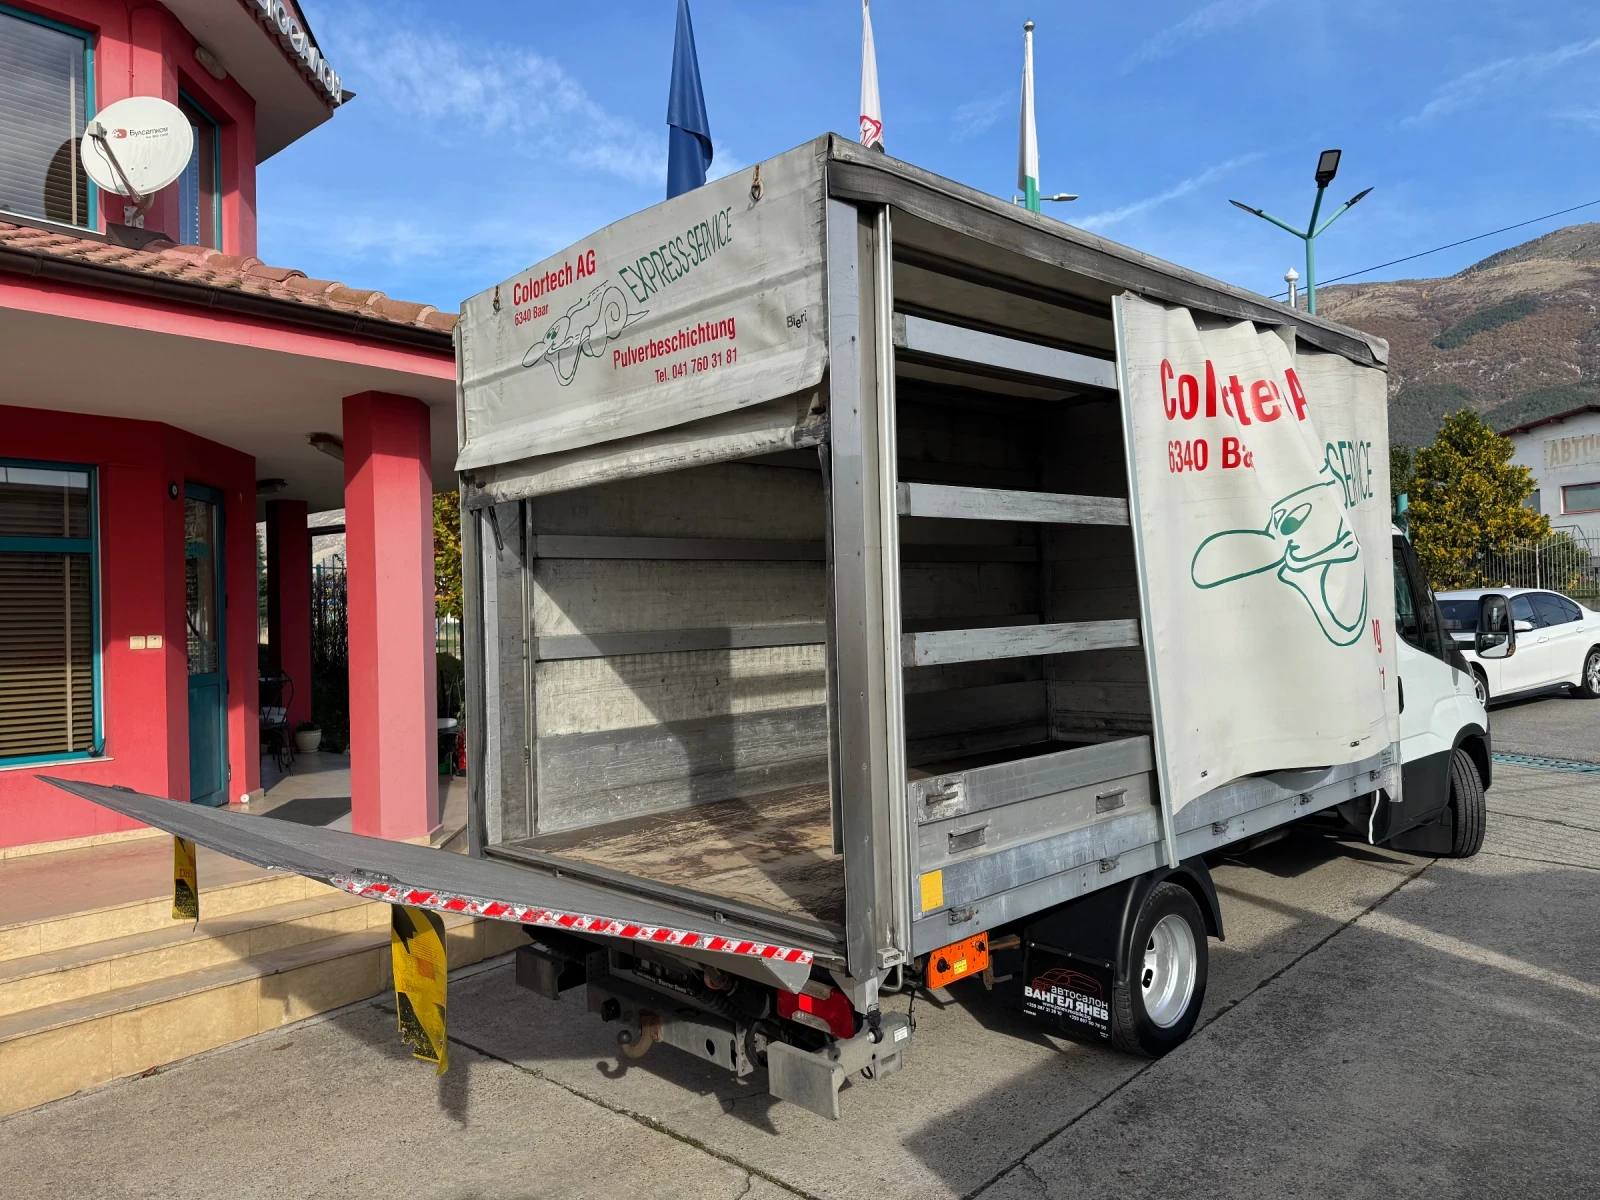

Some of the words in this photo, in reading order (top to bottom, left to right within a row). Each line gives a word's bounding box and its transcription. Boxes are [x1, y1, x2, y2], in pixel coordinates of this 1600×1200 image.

[618, 206, 732, 303] EXPRESS-SERVICE
[513, 261, 573, 306] Colortech
[576, 249, 596, 280] AG
[514, 308, 532, 326] 6340
[533, 304, 549, 319] Baar
[786, 309, 808, 329] Bieri
[613, 317, 736, 370] Pulverbeschichtung
[654, 368, 670, 383] Tel.
[672, 360, 688, 379] 041
[691, 355, 709, 374] 760
[711, 350, 722, 369] 31
[726, 347, 738, 364] 81
[1168, 438, 1209, 473] 6340
[1024, 985, 1074, 1010] ВАНГЕЛ
[1075, 1001, 1109, 1021] ЯНЕВ
[1050, 985, 1109, 1010] автосалон
